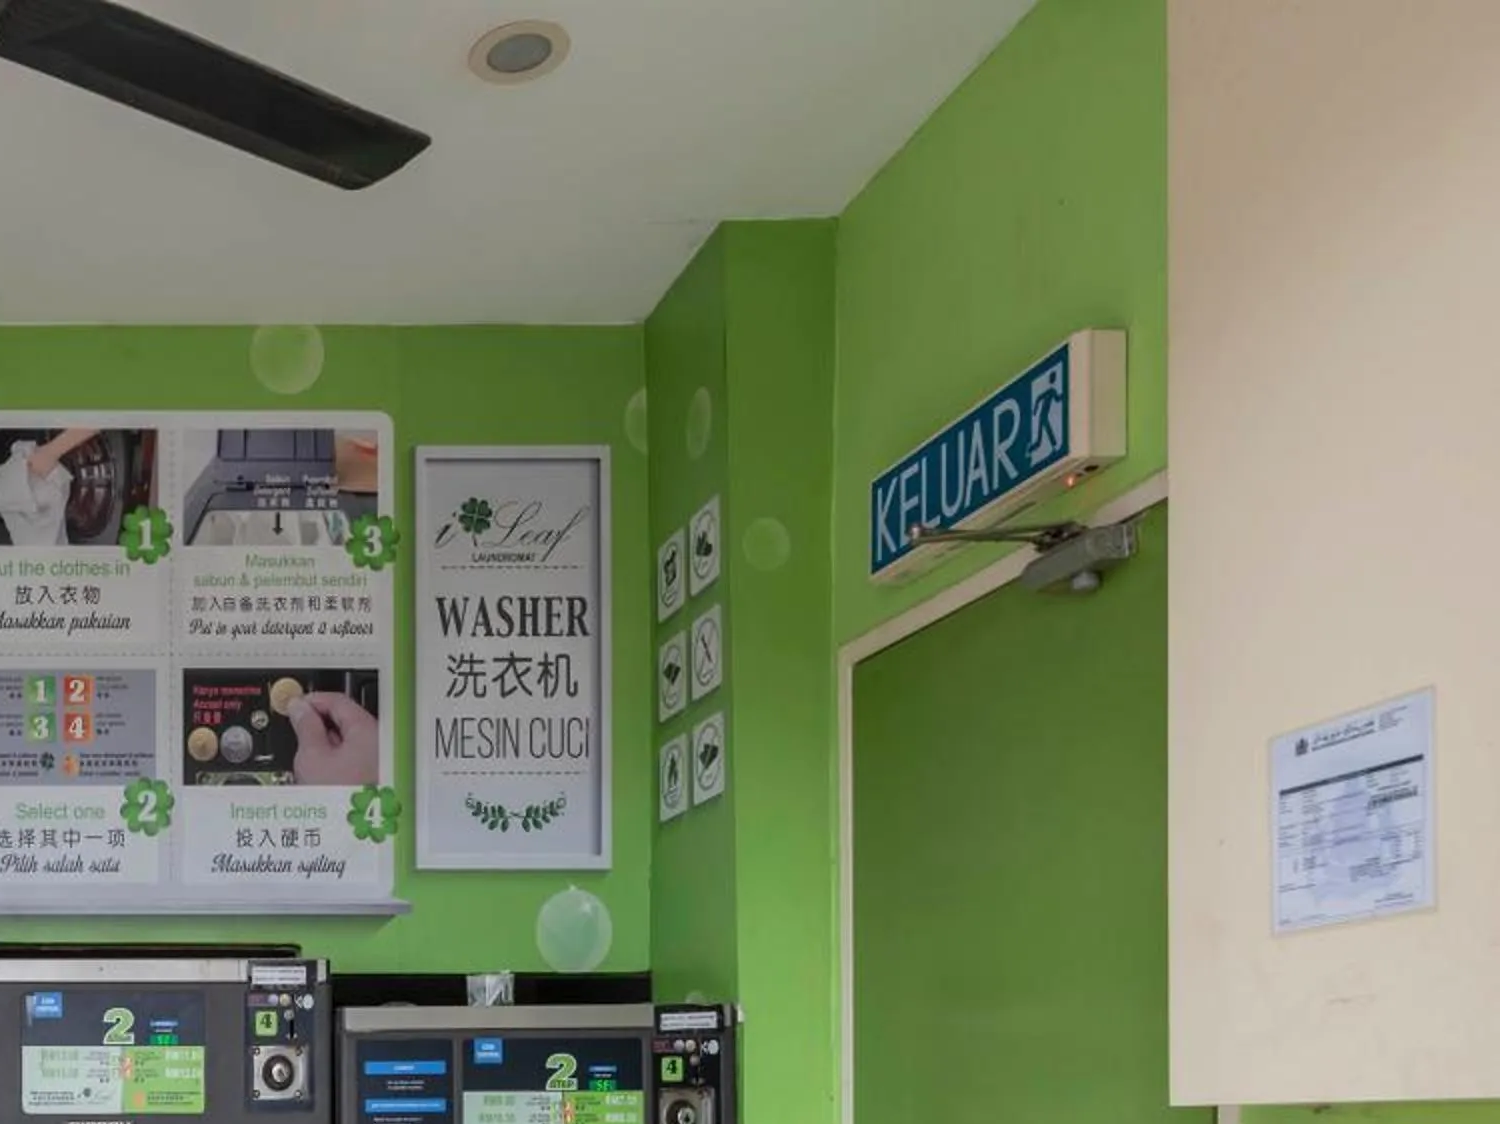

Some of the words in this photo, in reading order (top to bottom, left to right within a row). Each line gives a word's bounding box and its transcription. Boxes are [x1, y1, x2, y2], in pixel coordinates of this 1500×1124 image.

[877, 398, 1021, 561] KELUAR
[139, 519, 154, 550] 1
[363, 525, 383, 557] 3
[482, 499, 591, 562] Leaf
[19, 560, 45, 577] the
[50, 560, 110, 577] clothes
[114, 561, 131, 577] in
[15, 585, 101, 606] 放入衣物
[436, 596, 590, 637] WASHER
[446, 651, 579, 698] 洗衣机
[35, 679, 48, 703] 1
[68, 679, 85, 703] 2
[33, 716, 49, 740] 3
[68, 716, 85, 739] 4
[435, 717, 520, 759] MESIN
[529, 717, 590, 759] CUCI
[16, 803, 68, 820] Select
[73, 806, 105, 820] one
[137, 790, 158, 823] 2
[231, 802, 278, 820] Insert
[284, 804, 326, 820] coins
[364, 797, 384, 829] 4
[236, 828, 321, 848] 投入硬币
[103, 1007, 135, 1045] 2
[260, 1013, 272, 1029] 4
[545, 1052, 577, 1090] 2
[666, 1060, 677, 1075] 4
